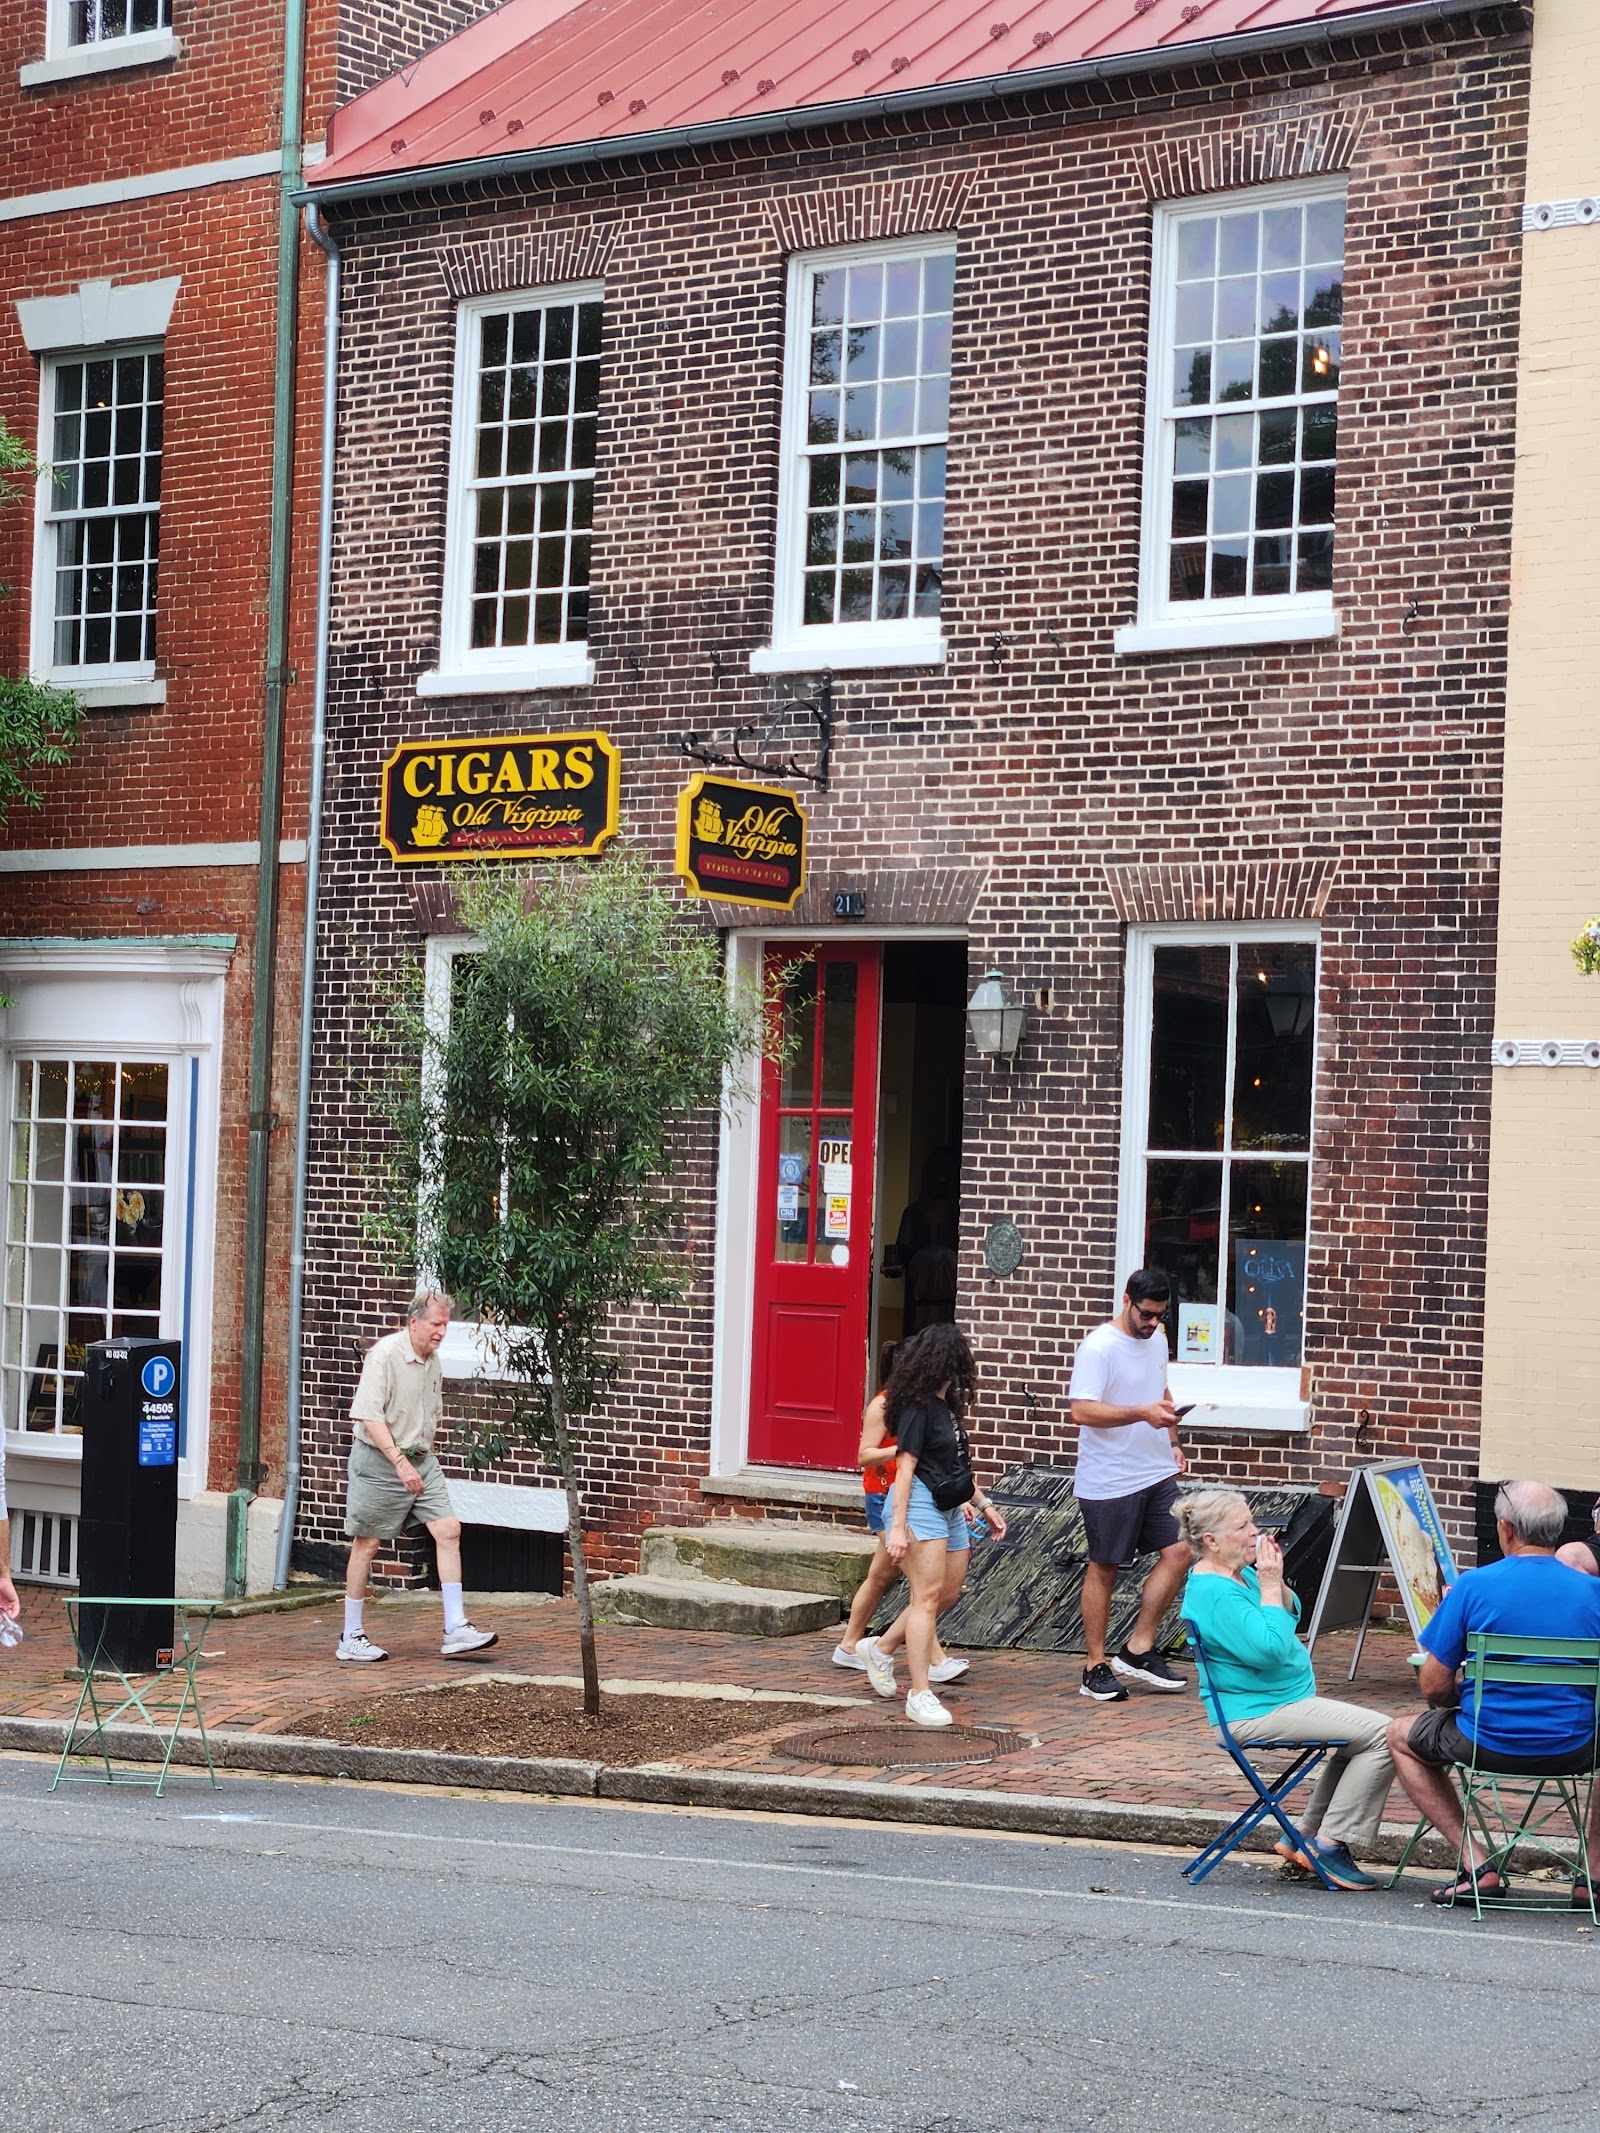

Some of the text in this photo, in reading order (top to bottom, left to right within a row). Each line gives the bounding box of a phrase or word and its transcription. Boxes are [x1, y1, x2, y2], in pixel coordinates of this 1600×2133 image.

[403, 746, 594, 798] CIGARS
[452, 795, 584, 833] Old Virginia
[725, 806, 798, 860] Old Virginia
[704, 861, 762, 879] TOBACCO
[820, 1141, 852, 1164] OPE
[113, 1350, 128, 1359] 02-02
[153, 1363, 168, 1391] P
[142, 1403, 174, 1414] 44505
[1409, 1478, 1424, 1494] BIG
